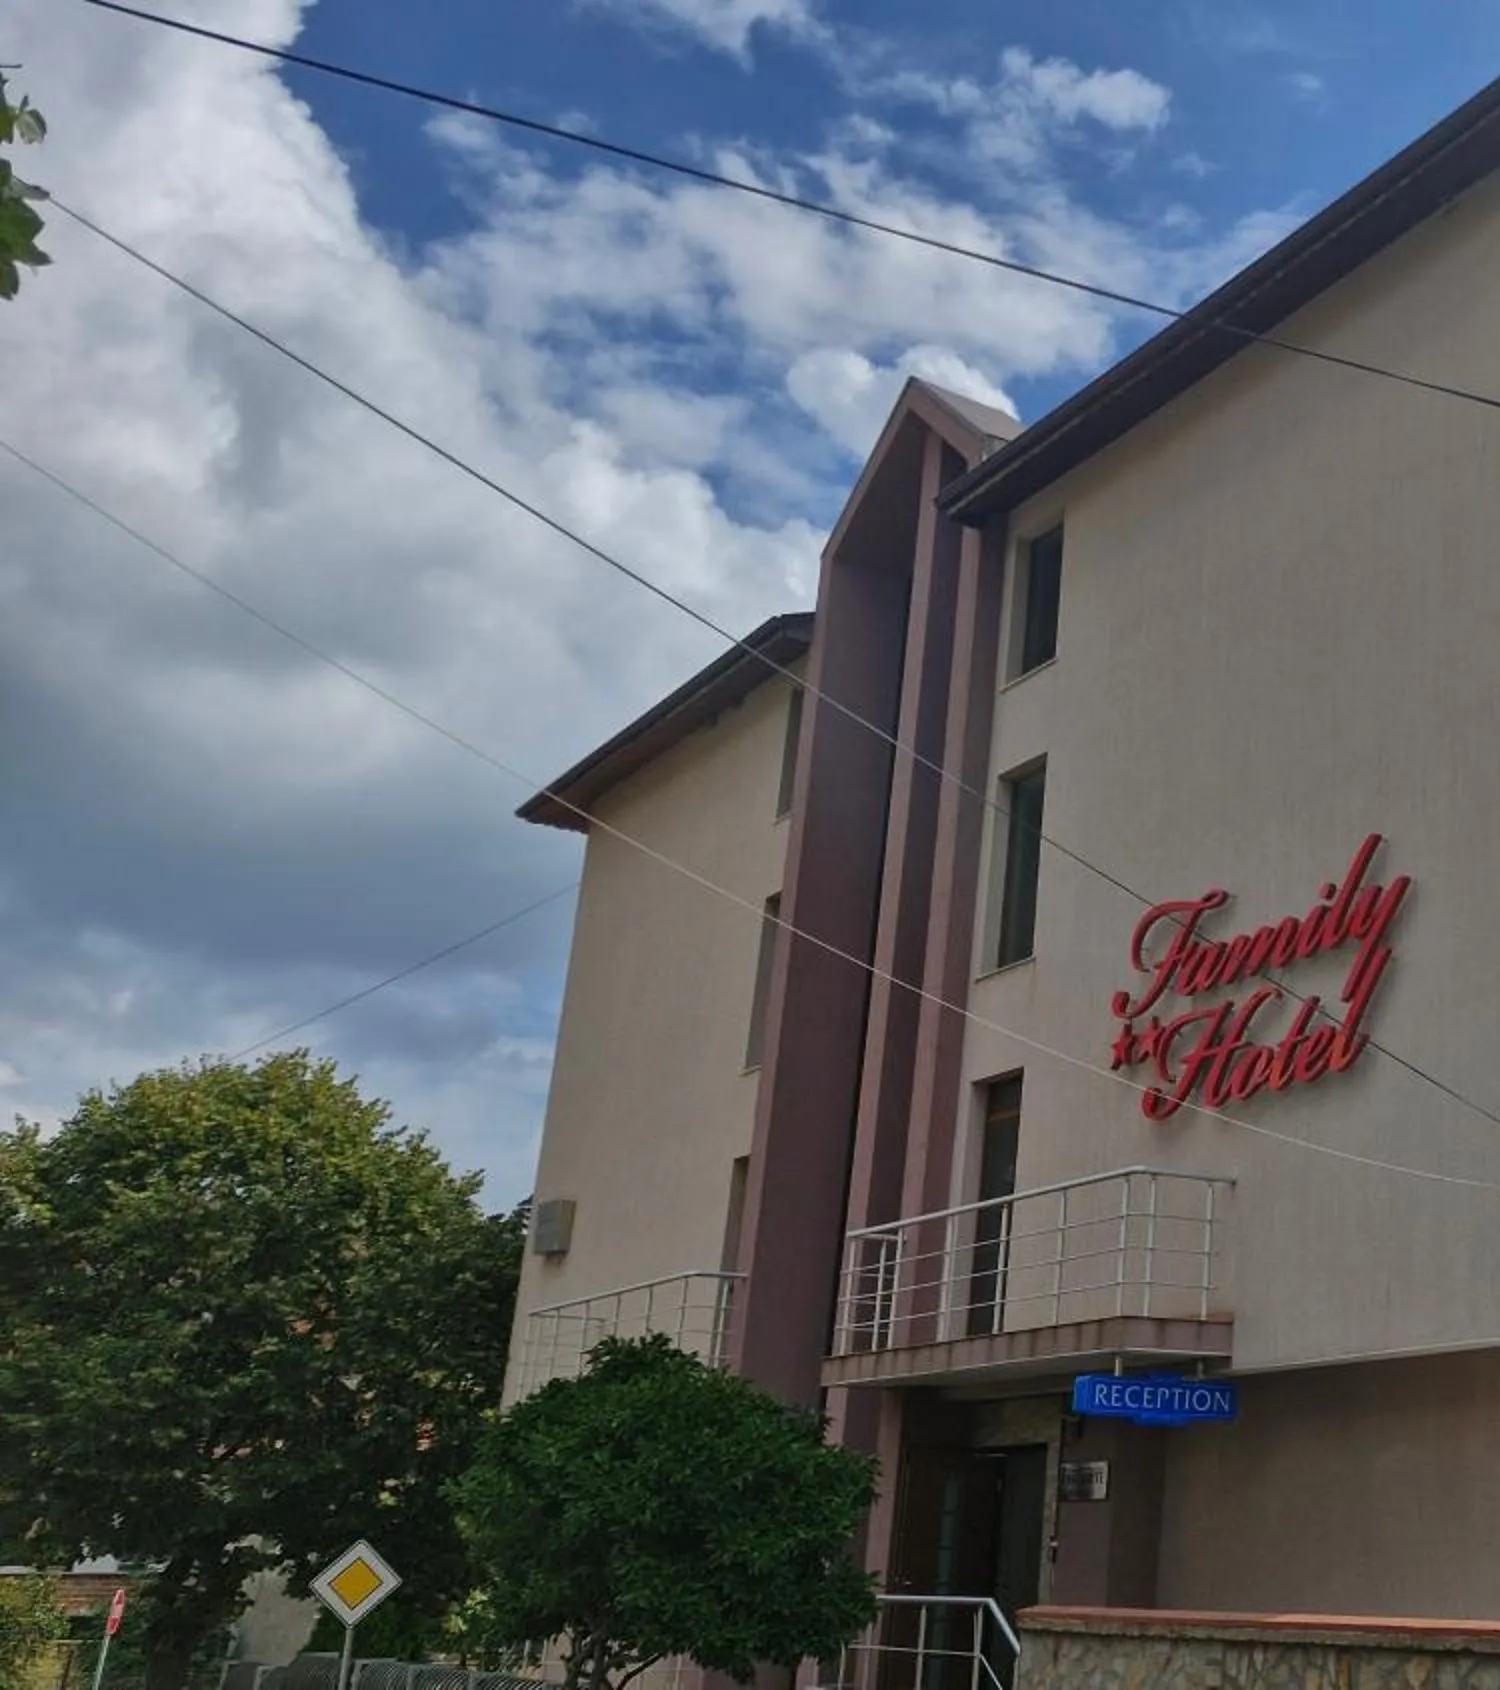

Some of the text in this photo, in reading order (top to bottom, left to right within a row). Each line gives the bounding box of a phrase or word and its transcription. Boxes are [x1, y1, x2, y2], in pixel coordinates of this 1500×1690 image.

[1111, 833, 1411, 1019] Family
[1141, 947, 1391, 1120] Hotel
[1095, 1384, 1231, 1412] RECEPTION
